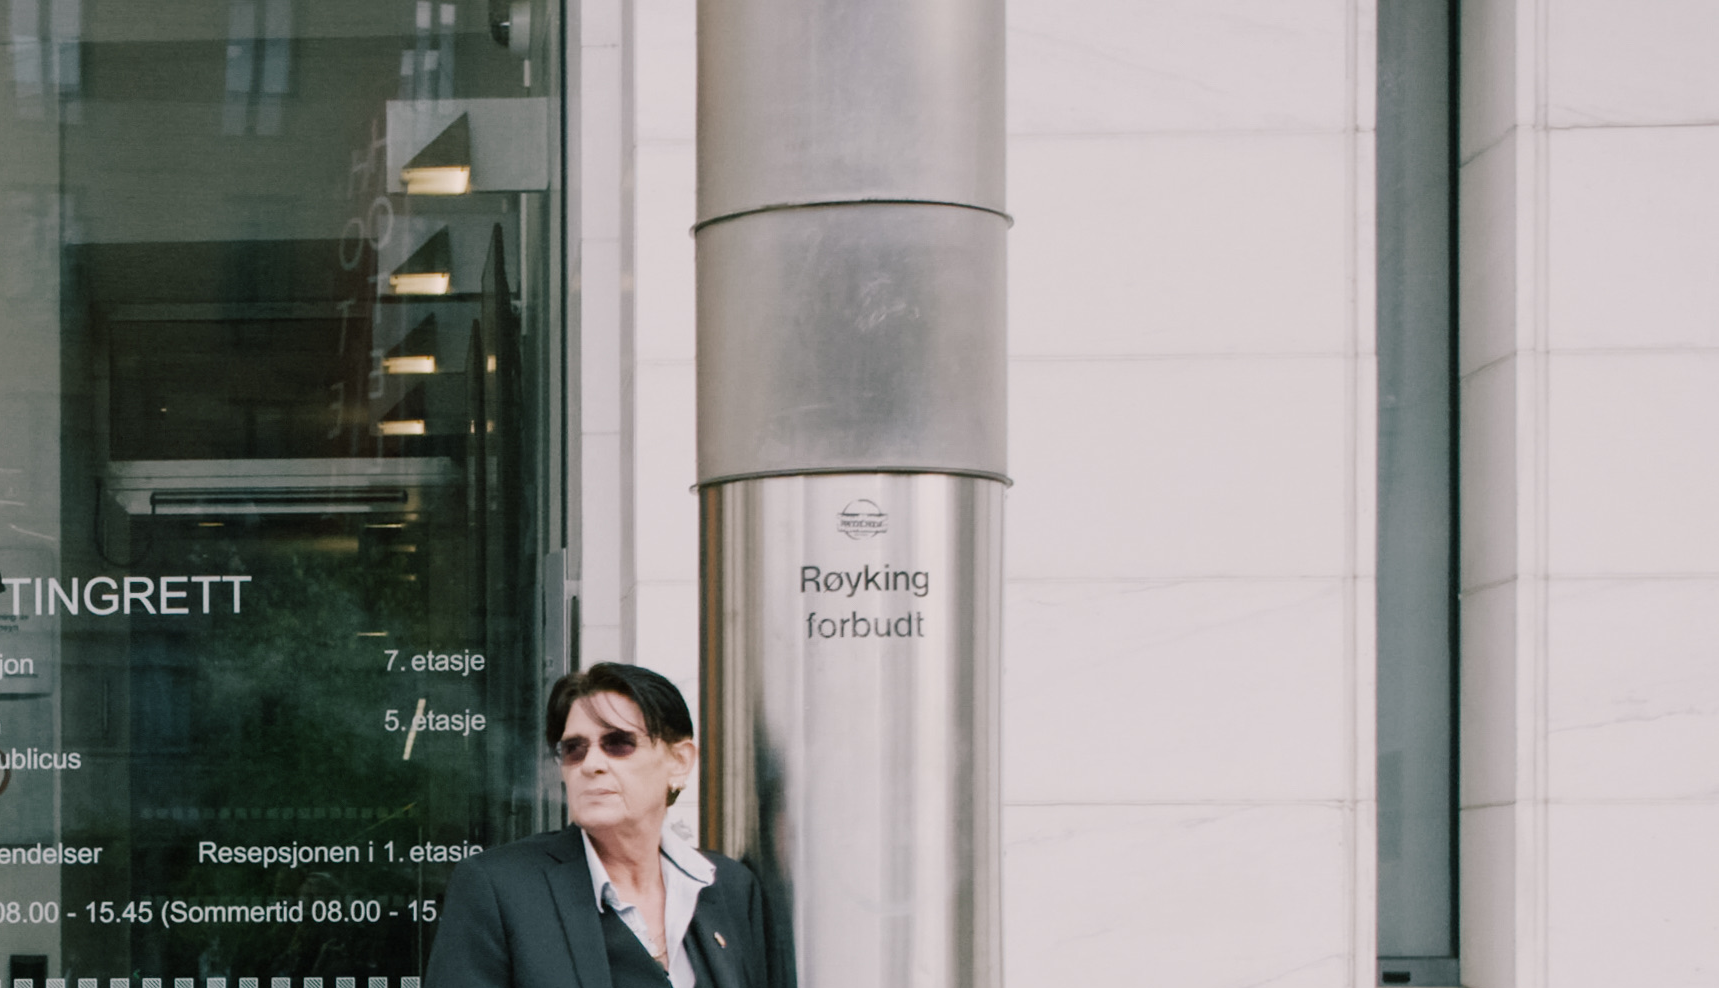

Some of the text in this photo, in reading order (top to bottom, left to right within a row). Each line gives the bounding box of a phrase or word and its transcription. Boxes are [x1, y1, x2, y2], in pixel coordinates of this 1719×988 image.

[800, 564, 929, 598] Røyking
[1, 575, 252, 616] TINGRETT
[805, 610, 924, 639] forbudt
[384, 649, 485, 676] 7. etasje
[384, 709, 486, 736] 5. etasje
[199, 841, 359, 869] Resepsjonen
[368, 841, 374, 862] i
[384, 841, 404, 862] 1.
[86, 901, 153, 923] 15.45
[161, 900, 303, 928] (Sommertid
[312, 900, 381, 922] 08.00
